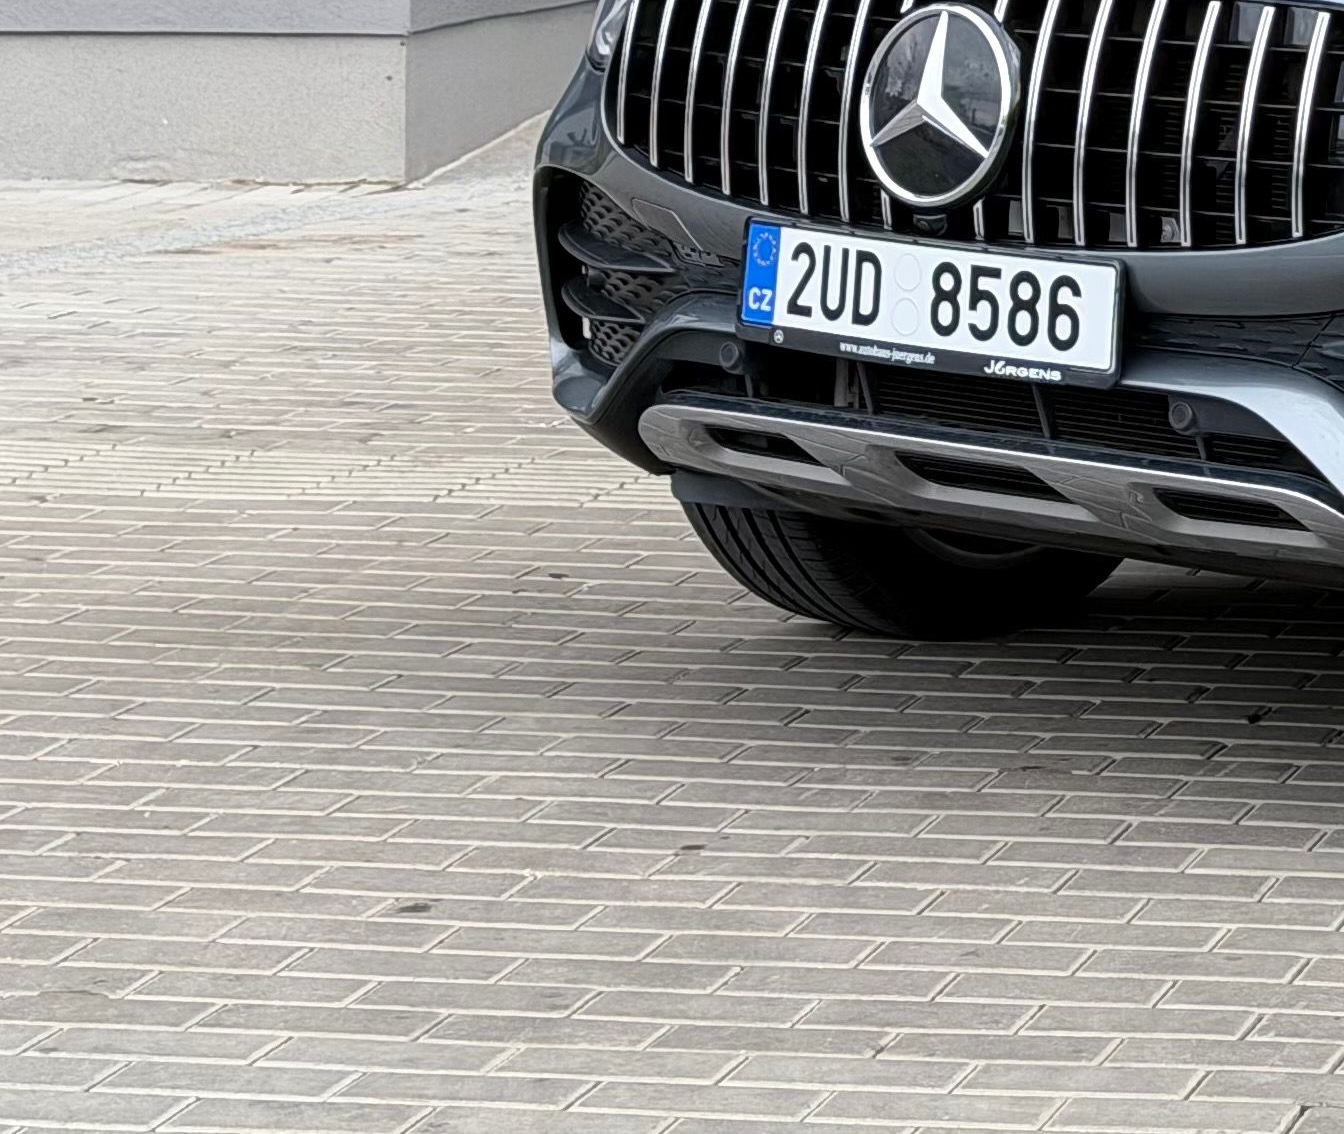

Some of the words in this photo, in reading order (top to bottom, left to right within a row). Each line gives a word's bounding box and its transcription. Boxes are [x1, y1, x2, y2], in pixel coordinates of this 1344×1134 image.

[748, 286, 773, 312] CZ
[786, 241, 883, 327] 2UD
[930, 260, 1083, 352] 8586
